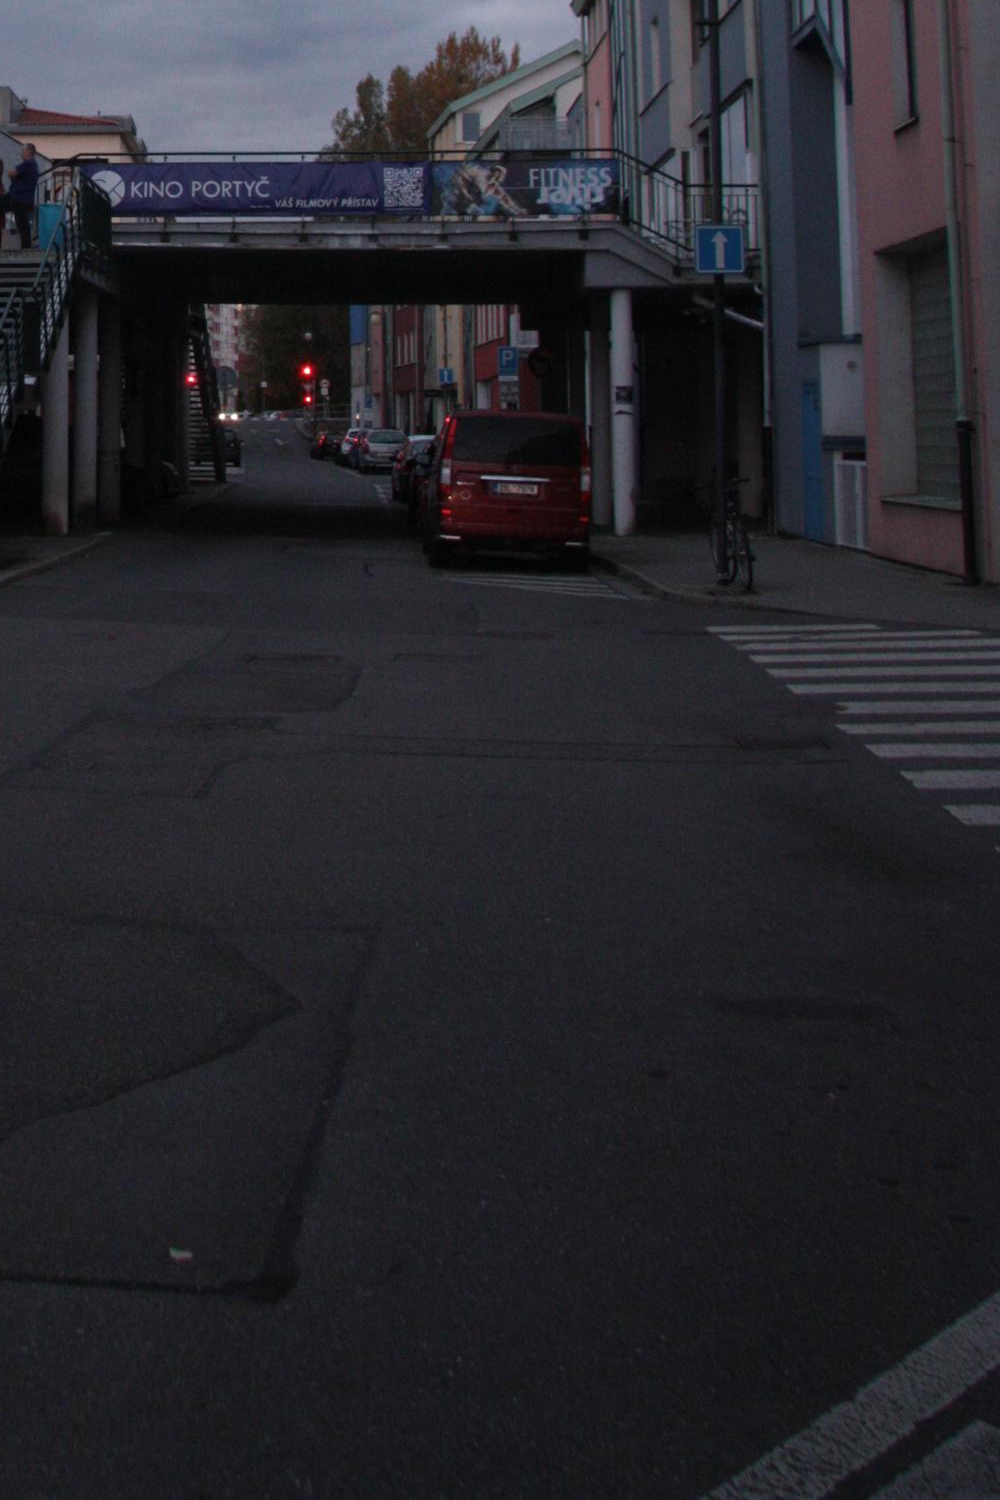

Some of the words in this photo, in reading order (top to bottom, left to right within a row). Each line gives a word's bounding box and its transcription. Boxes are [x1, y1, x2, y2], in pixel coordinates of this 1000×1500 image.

[130, 180, 184, 199] KINO
[191, 176, 270, 198] PORTYČ
[529, 167, 612, 189] FITNESS
[502, 350, 514, 366] P
